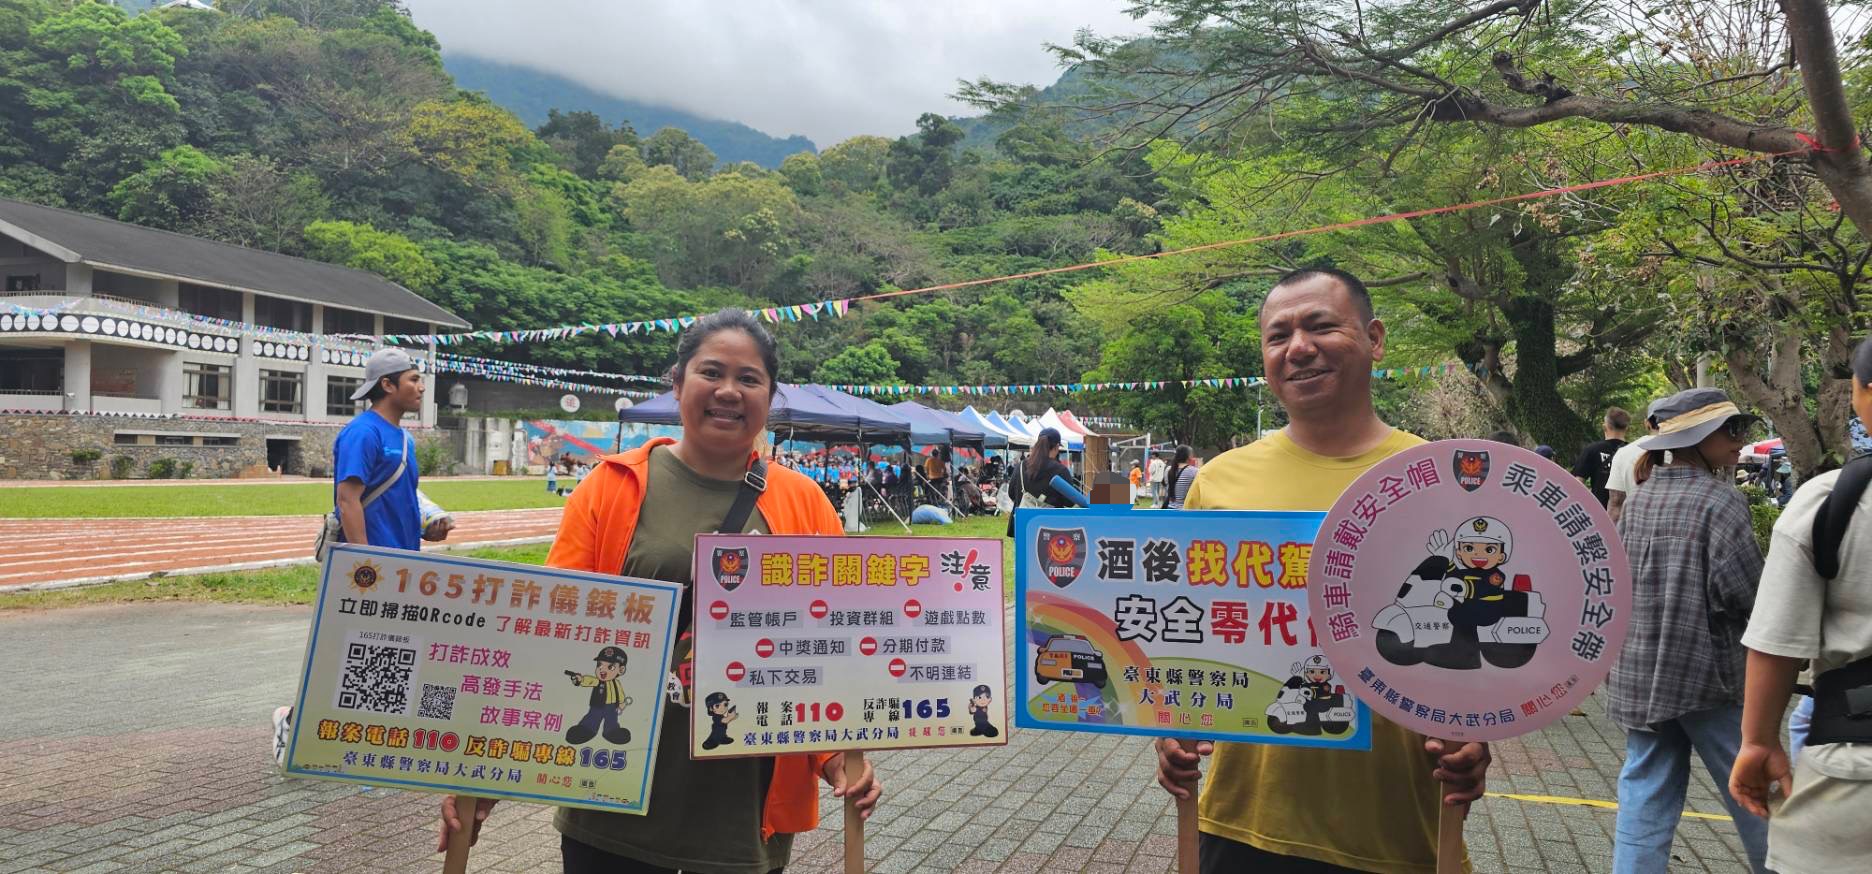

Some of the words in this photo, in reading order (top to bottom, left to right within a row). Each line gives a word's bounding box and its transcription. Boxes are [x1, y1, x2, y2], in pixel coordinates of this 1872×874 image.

[1460, 477, 1481, 485] POLICE
[1323, 457, 1441, 643] 騎車請戴安全帽
[761, 553, 930, 587] 識詐關鍵字
[1048, 566, 1075, 577] POLICE
[1502, 462, 1615, 662] 乘車請繫安全帶
[720, 575, 740, 584] POLICE
[396, 567, 656, 625] 165打詐儀錶板
[338, 597, 487, 628] 立即掃描QRcode
[730, 610, 797, 627] 監管帳戶
[830, 609, 894, 626] 投資群組
[925, 609, 986, 625] 遊戲點數
[1115, 594, 1318, 648] 安全零代
[496, 615, 651, 650] 了解最新打詐資訊
[1415, 621, 1450, 631] 交通警察
[1507, 626, 1541, 635] POLICE
[428, 642, 512, 669] 打詐成效
[779, 639, 845, 656] 中獎通知
[882, 638, 945, 653] 分期付款
[749, 669, 817, 686] 私下交易
[910, 665, 972, 680] 不明連結
[1123, 665, 1249, 688] 臺東縣警察局
[460, 674, 543, 701] 高發手法
[1358, 666, 1515, 727] 臺東縣警察局大武分局
[902, 698, 951, 719] 165
[1139, 688, 1233, 710] 大武分局
[1520, 682, 1567, 717] 關心您
[480, 705, 564, 734] 故事案例
[795, 702, 844, 723] 110
[744, 726, 899, 746] 臺東縣警察局大武分局
[342, 751, 522, 784] 臺東縣警察局大武分局
